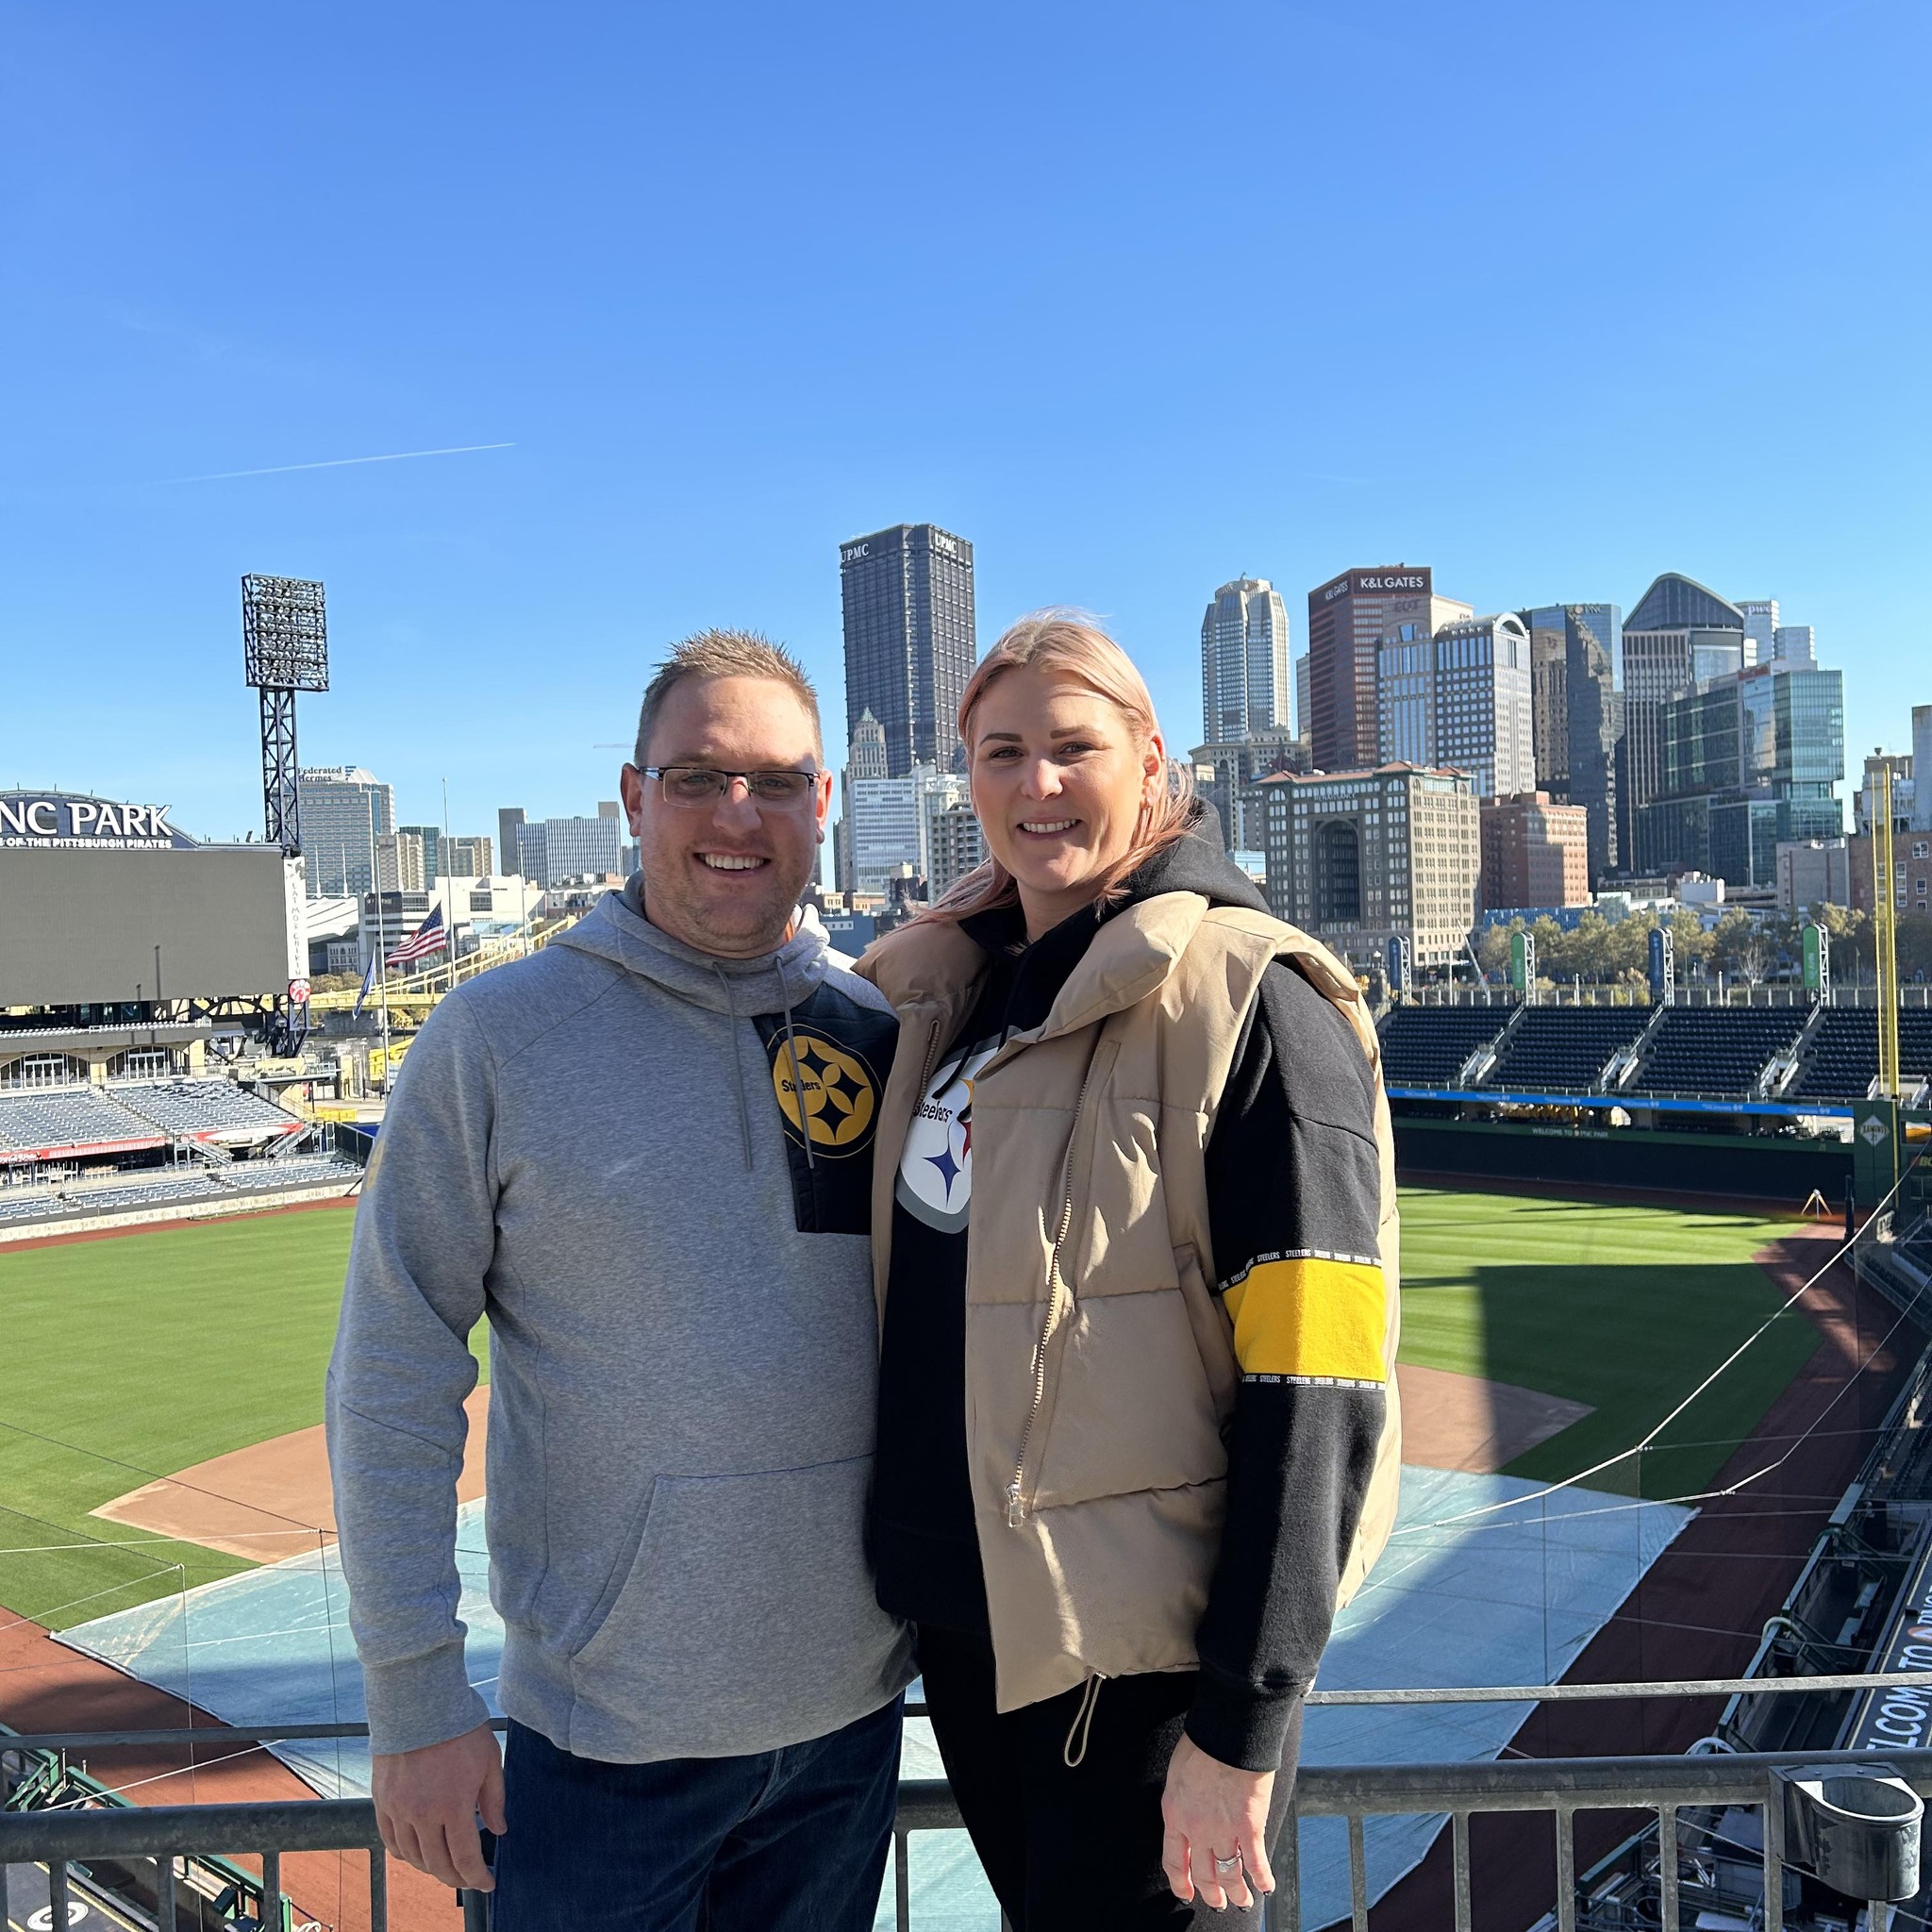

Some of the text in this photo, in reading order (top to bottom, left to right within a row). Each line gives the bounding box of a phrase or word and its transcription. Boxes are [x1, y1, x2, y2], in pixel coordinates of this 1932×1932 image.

[934, 533, 958, 554] UPMC
[841, 543, 870, 563] UPMC
[1360, 576, 1424, 589] K&L GATES
[298, 766, 341, 774] Federated
[66, 803, 174, 837] PARK
[7, 837, 24, 847] OF
[26, 838, 51, 848] THE
[53, 838, 125, 849] PITTSBURGH
[126, 839, 173, 849] PIRATES
[1257, 1251, 1281, 1263] STEELERS
[1285, 1248, 1311, 1258] STEELERS
[1259, 1374, 1281, 1383] STEELERS
[1286, 1376, 1311, 1385] STEELERS
